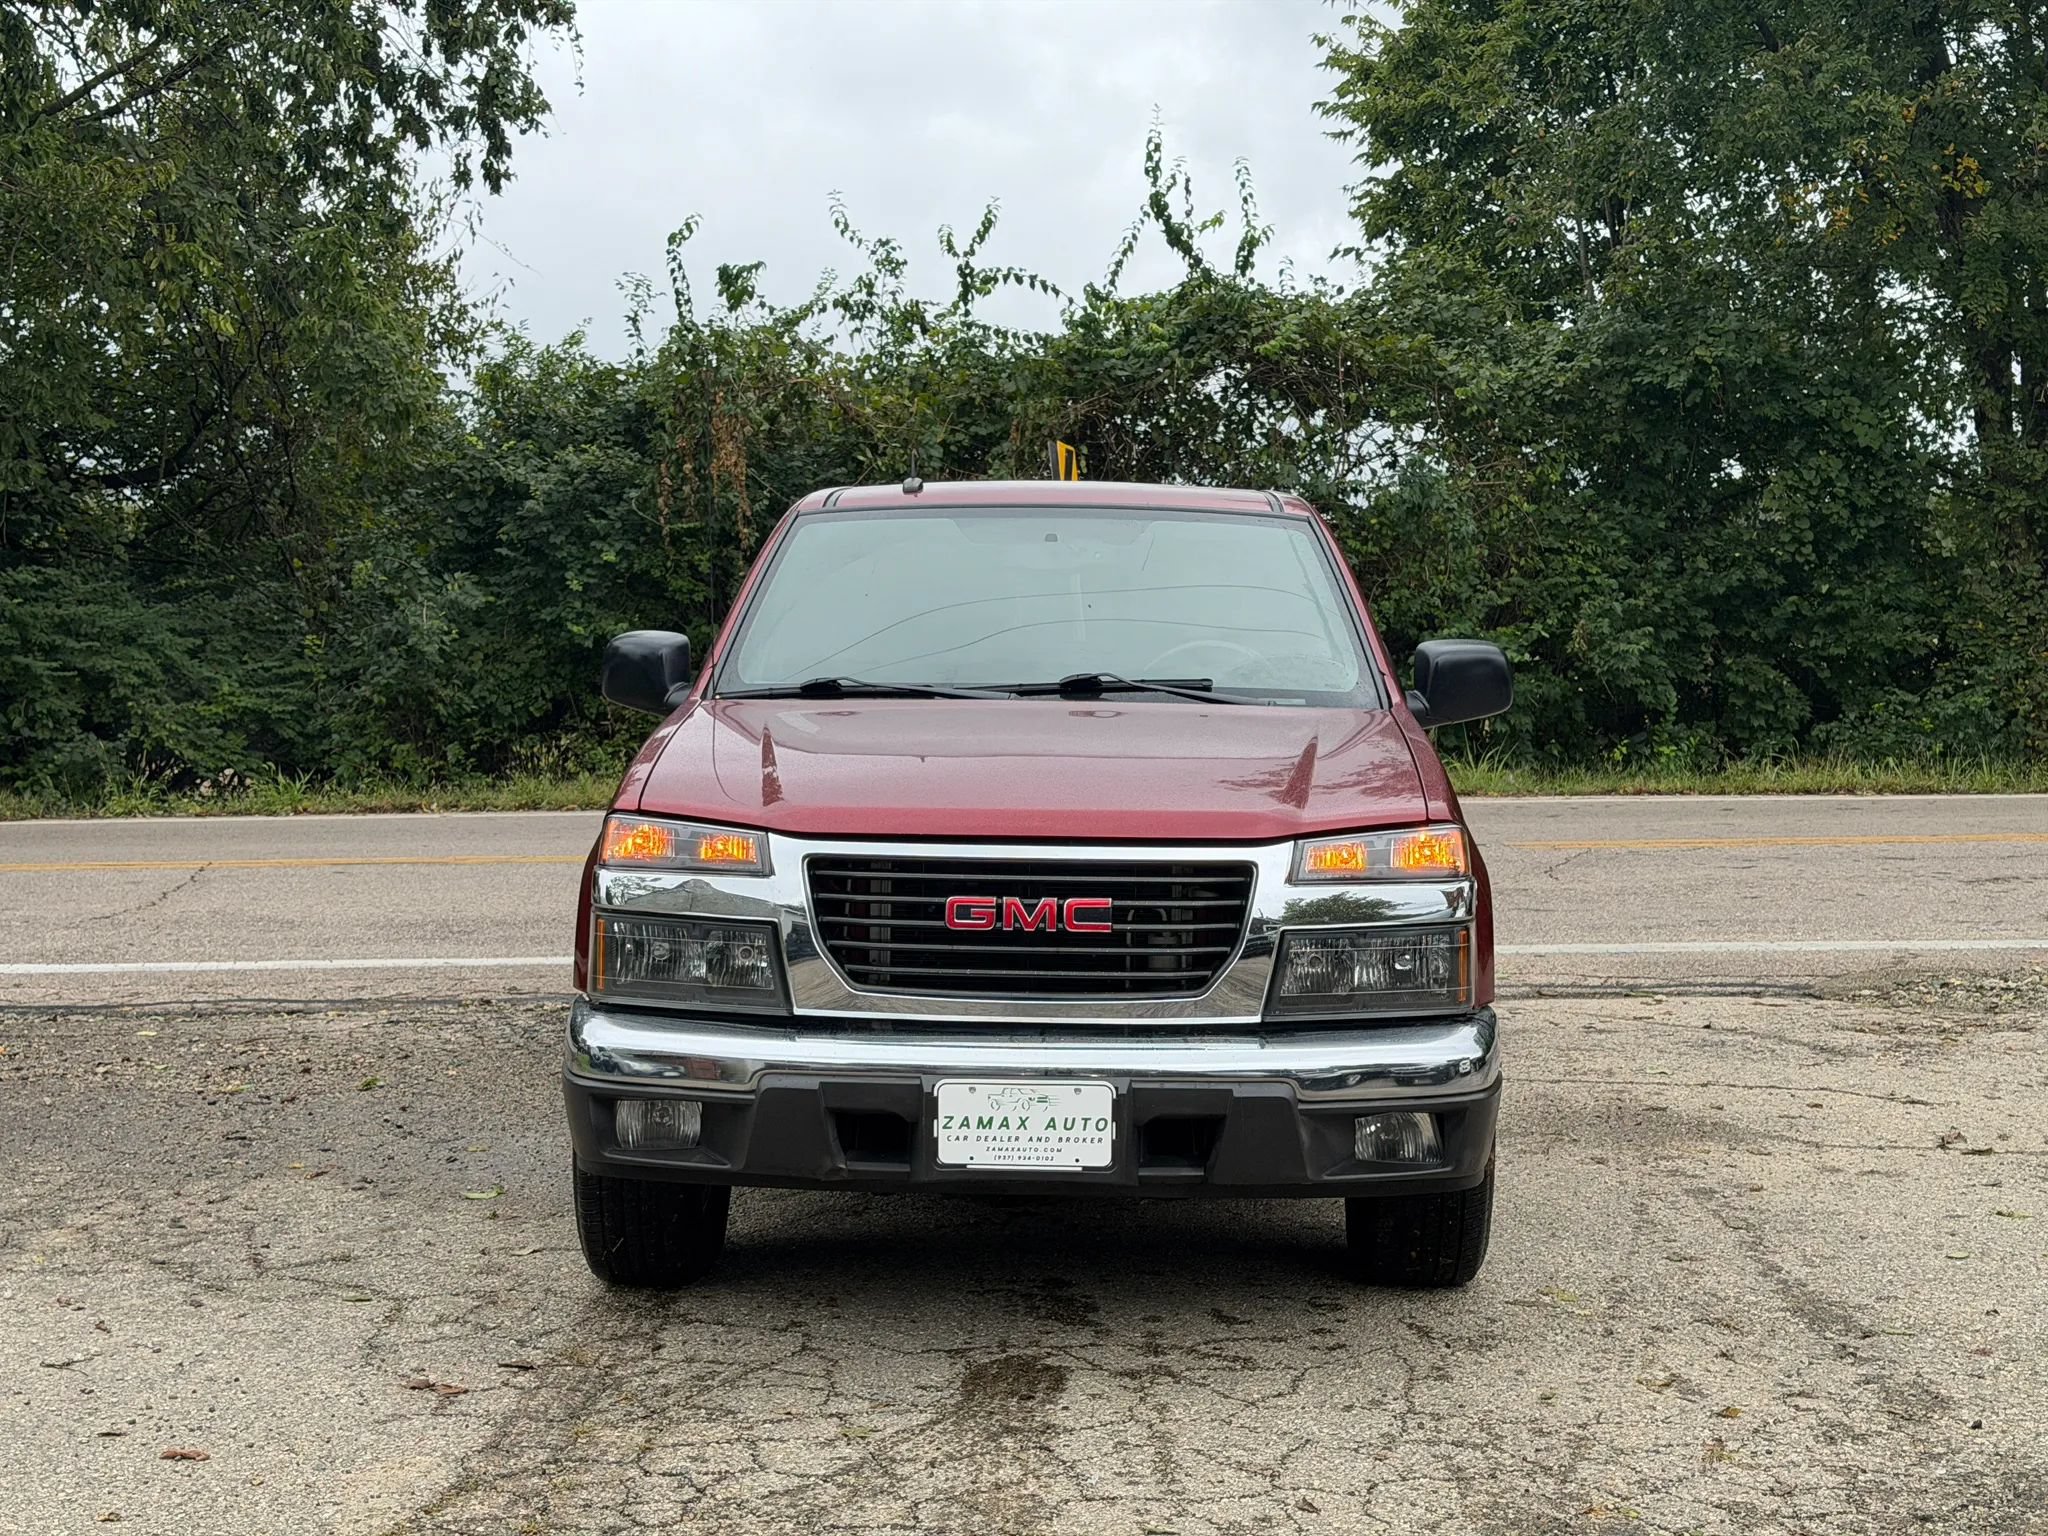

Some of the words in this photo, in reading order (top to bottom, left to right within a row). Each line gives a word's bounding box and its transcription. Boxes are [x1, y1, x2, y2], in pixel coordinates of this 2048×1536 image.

[945, 895, 1112, 932] GMC
[941, 1115, 1030, 1131] ZAMAX
[1044, 1116, 1109, 1132] AUTO
[1057, 1136, 1104, 1144] BROKER
